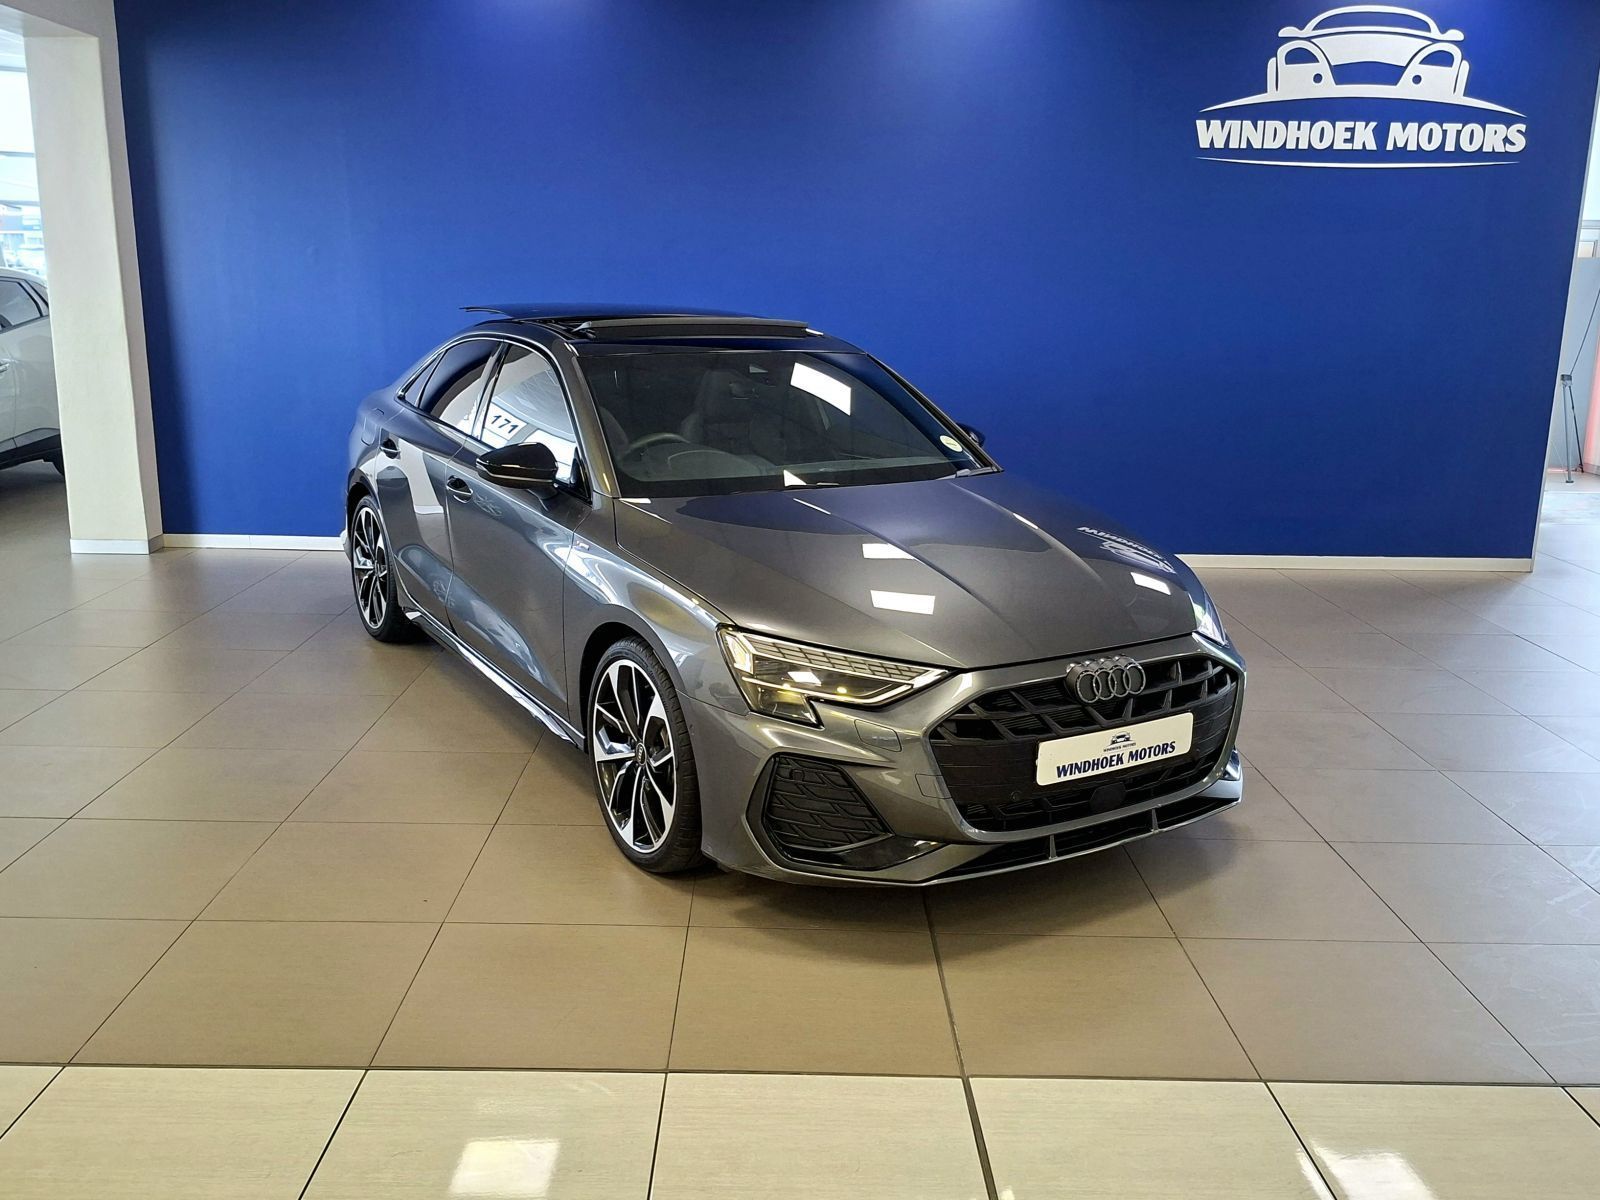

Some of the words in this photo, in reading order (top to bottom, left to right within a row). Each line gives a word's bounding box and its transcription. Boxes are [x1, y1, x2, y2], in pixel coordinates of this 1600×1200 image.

[1196, 120, 1379, 151] WINDHOEK
[1386, 122, 1526, 153] MOTORS
[491, 415, 519, 434] 171
[1056, 752, 1125, 778] WINDHOEK
[1128, 741, 1176, 763] MOTORS
